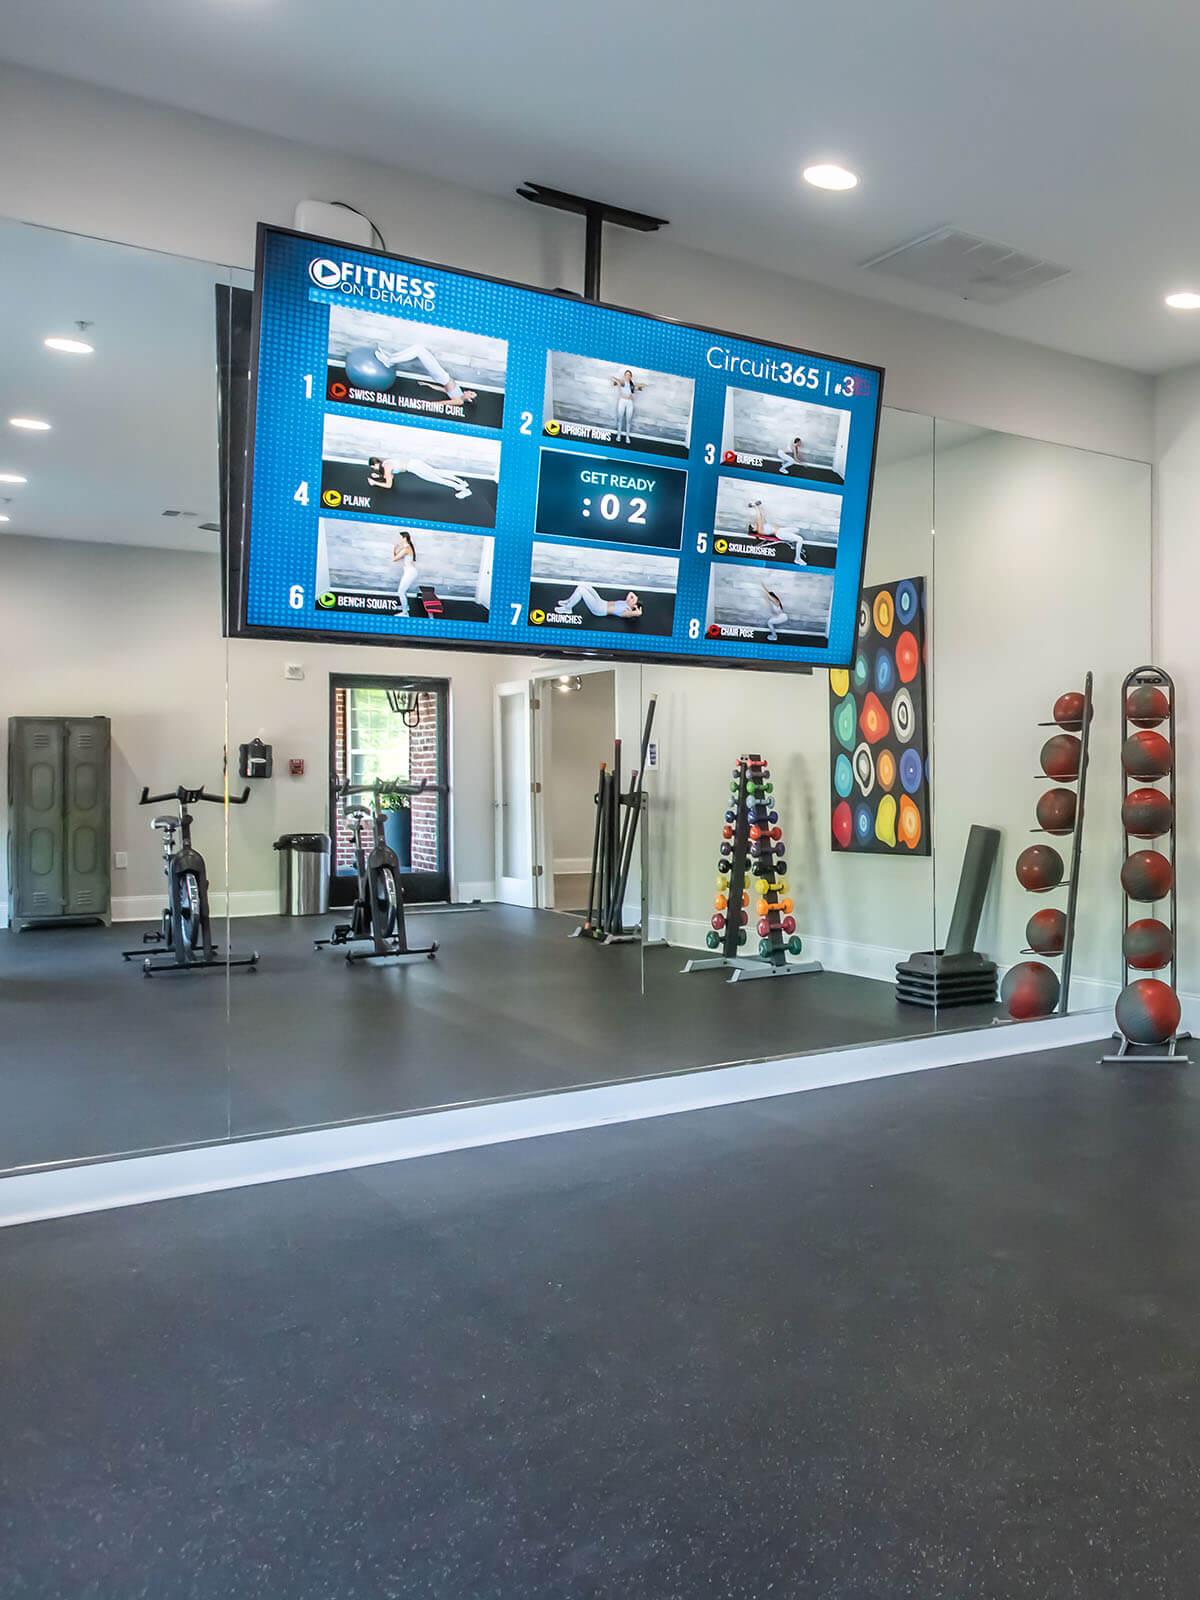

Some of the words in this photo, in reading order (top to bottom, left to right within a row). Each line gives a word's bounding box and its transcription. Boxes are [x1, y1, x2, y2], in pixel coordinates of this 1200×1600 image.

[341, 262, 436, 299] FITNESS
[341, 281, 364, 297] ON
[370, 287, 435, 312] DEMAND
[706, 346, 819, 389] Circuit365
[303, 374, 312, 399] 1
[348, 387, 376, 402] SWISS
[376, 392, 397, 406] BALL
[398, 396, 444, 414] HAMSTRING
[445, 403, 465, 417] CURL
[520, 411, 533, 436] 2
[561, 424, 592, 438] UPRIGHT
[592, 429, 612, 441] ROWS
[704, 443, 716, 465] 3
[580, 470, 608, 485] GET
[610, 474, 656, 492] READY
[293, 480, 310, 506] 4
[343, 494, 371, 508] PLANK
[696, 532, 708, 553] 5
[728, 542, 776, 556] SKULLCRUSHERS
[289, 585, 304, 609] 6
[337, 596, 365, 608] BENCH
[366, 599, 398, 610] SQUATS
[510, 603, 522, 626] 7
[546, 613, 583, 625] CRUNCHES
[689, 618, 700, 640] 8
[720, 627, 740, 637] CHAIR
[739, 629, 754, 639] POSE
